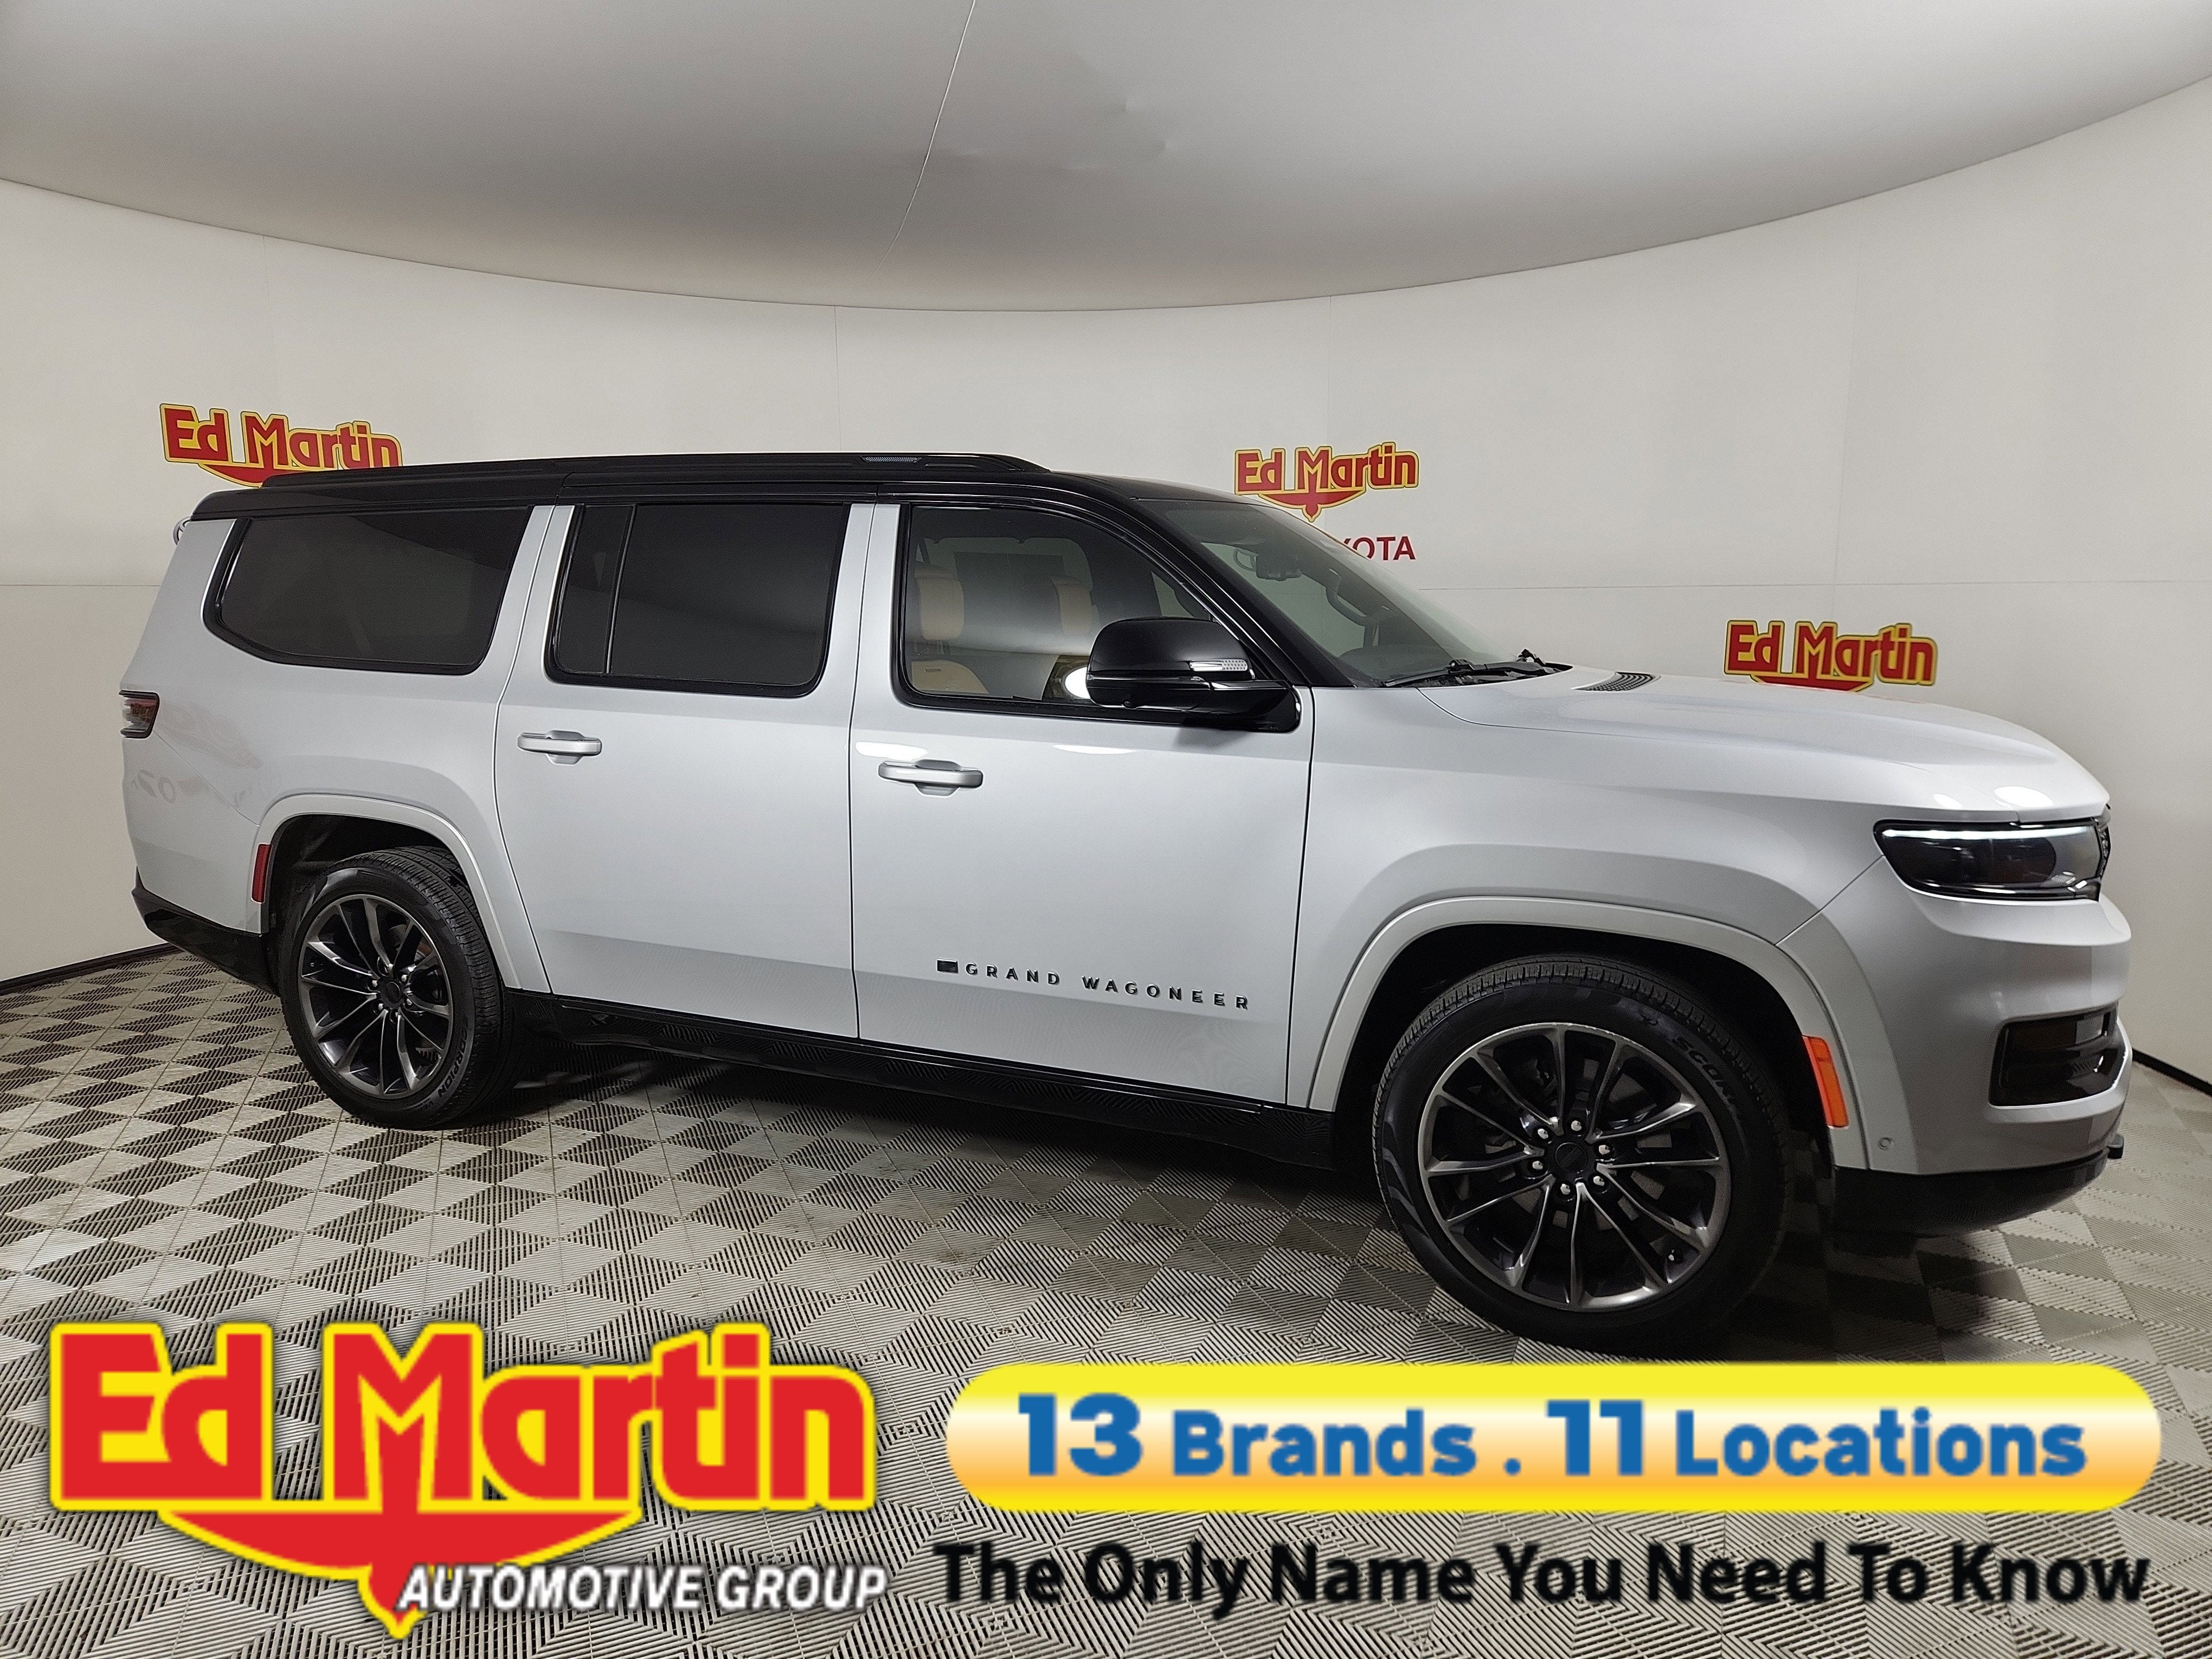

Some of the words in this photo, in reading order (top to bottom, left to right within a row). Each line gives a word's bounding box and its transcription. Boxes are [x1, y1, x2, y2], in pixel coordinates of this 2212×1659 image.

[159, 403, 232, 464] Ed
[240, 411, 403, 470] Martin
[1235, 448, 1285, 495] Ed
[1294, 441, 1419, 492] Martin
[1343, 536, 1416, 560] OTA
[1724, 620, 1785, 674] Ed
[1792, 621, 1938, 686] Martin
[965, 962, 1060, 985] GRAND
[1082, 975, 1248, 1010] WAGONEER
